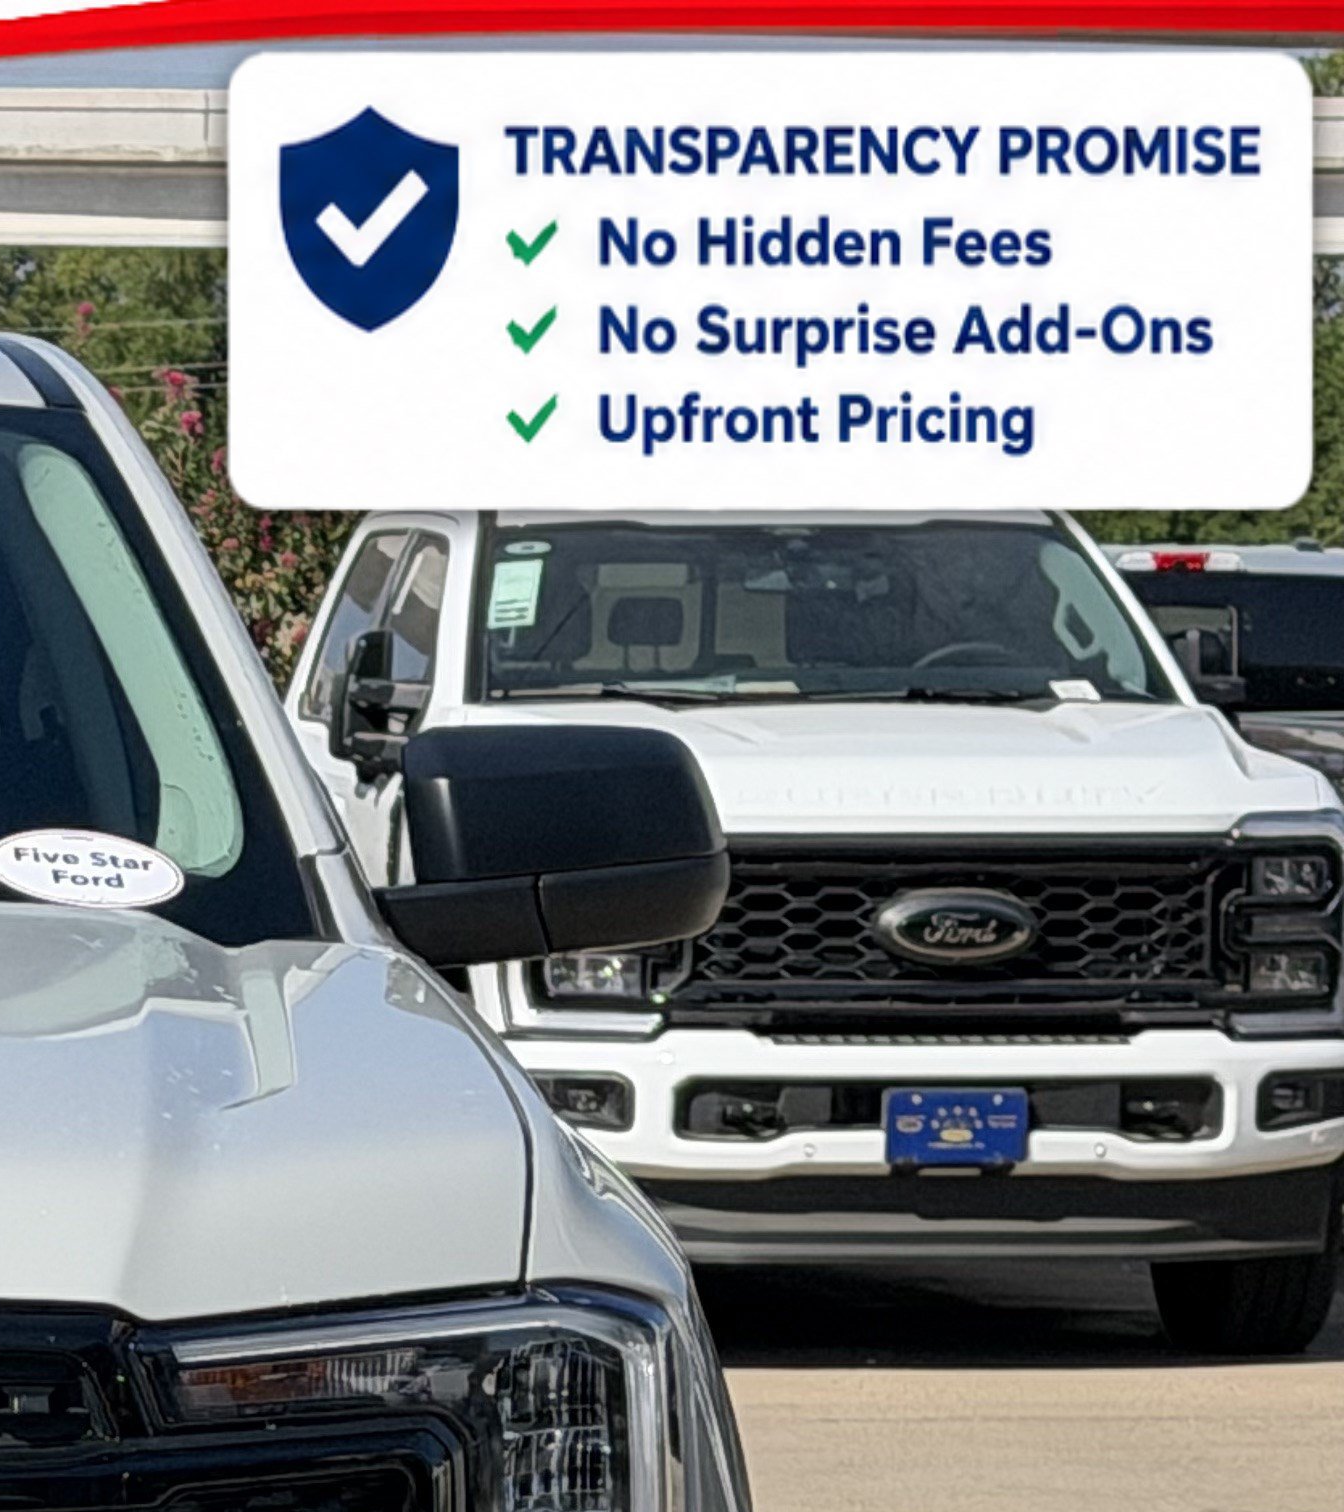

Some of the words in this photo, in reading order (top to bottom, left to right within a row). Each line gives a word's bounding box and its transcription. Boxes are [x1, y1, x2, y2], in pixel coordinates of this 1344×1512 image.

[13, 846, 80, 865] Five
[89, 851, 153, 871] Star
[51, 869, 125, 889] Ford
[923, 912, 998, 944] Ford
